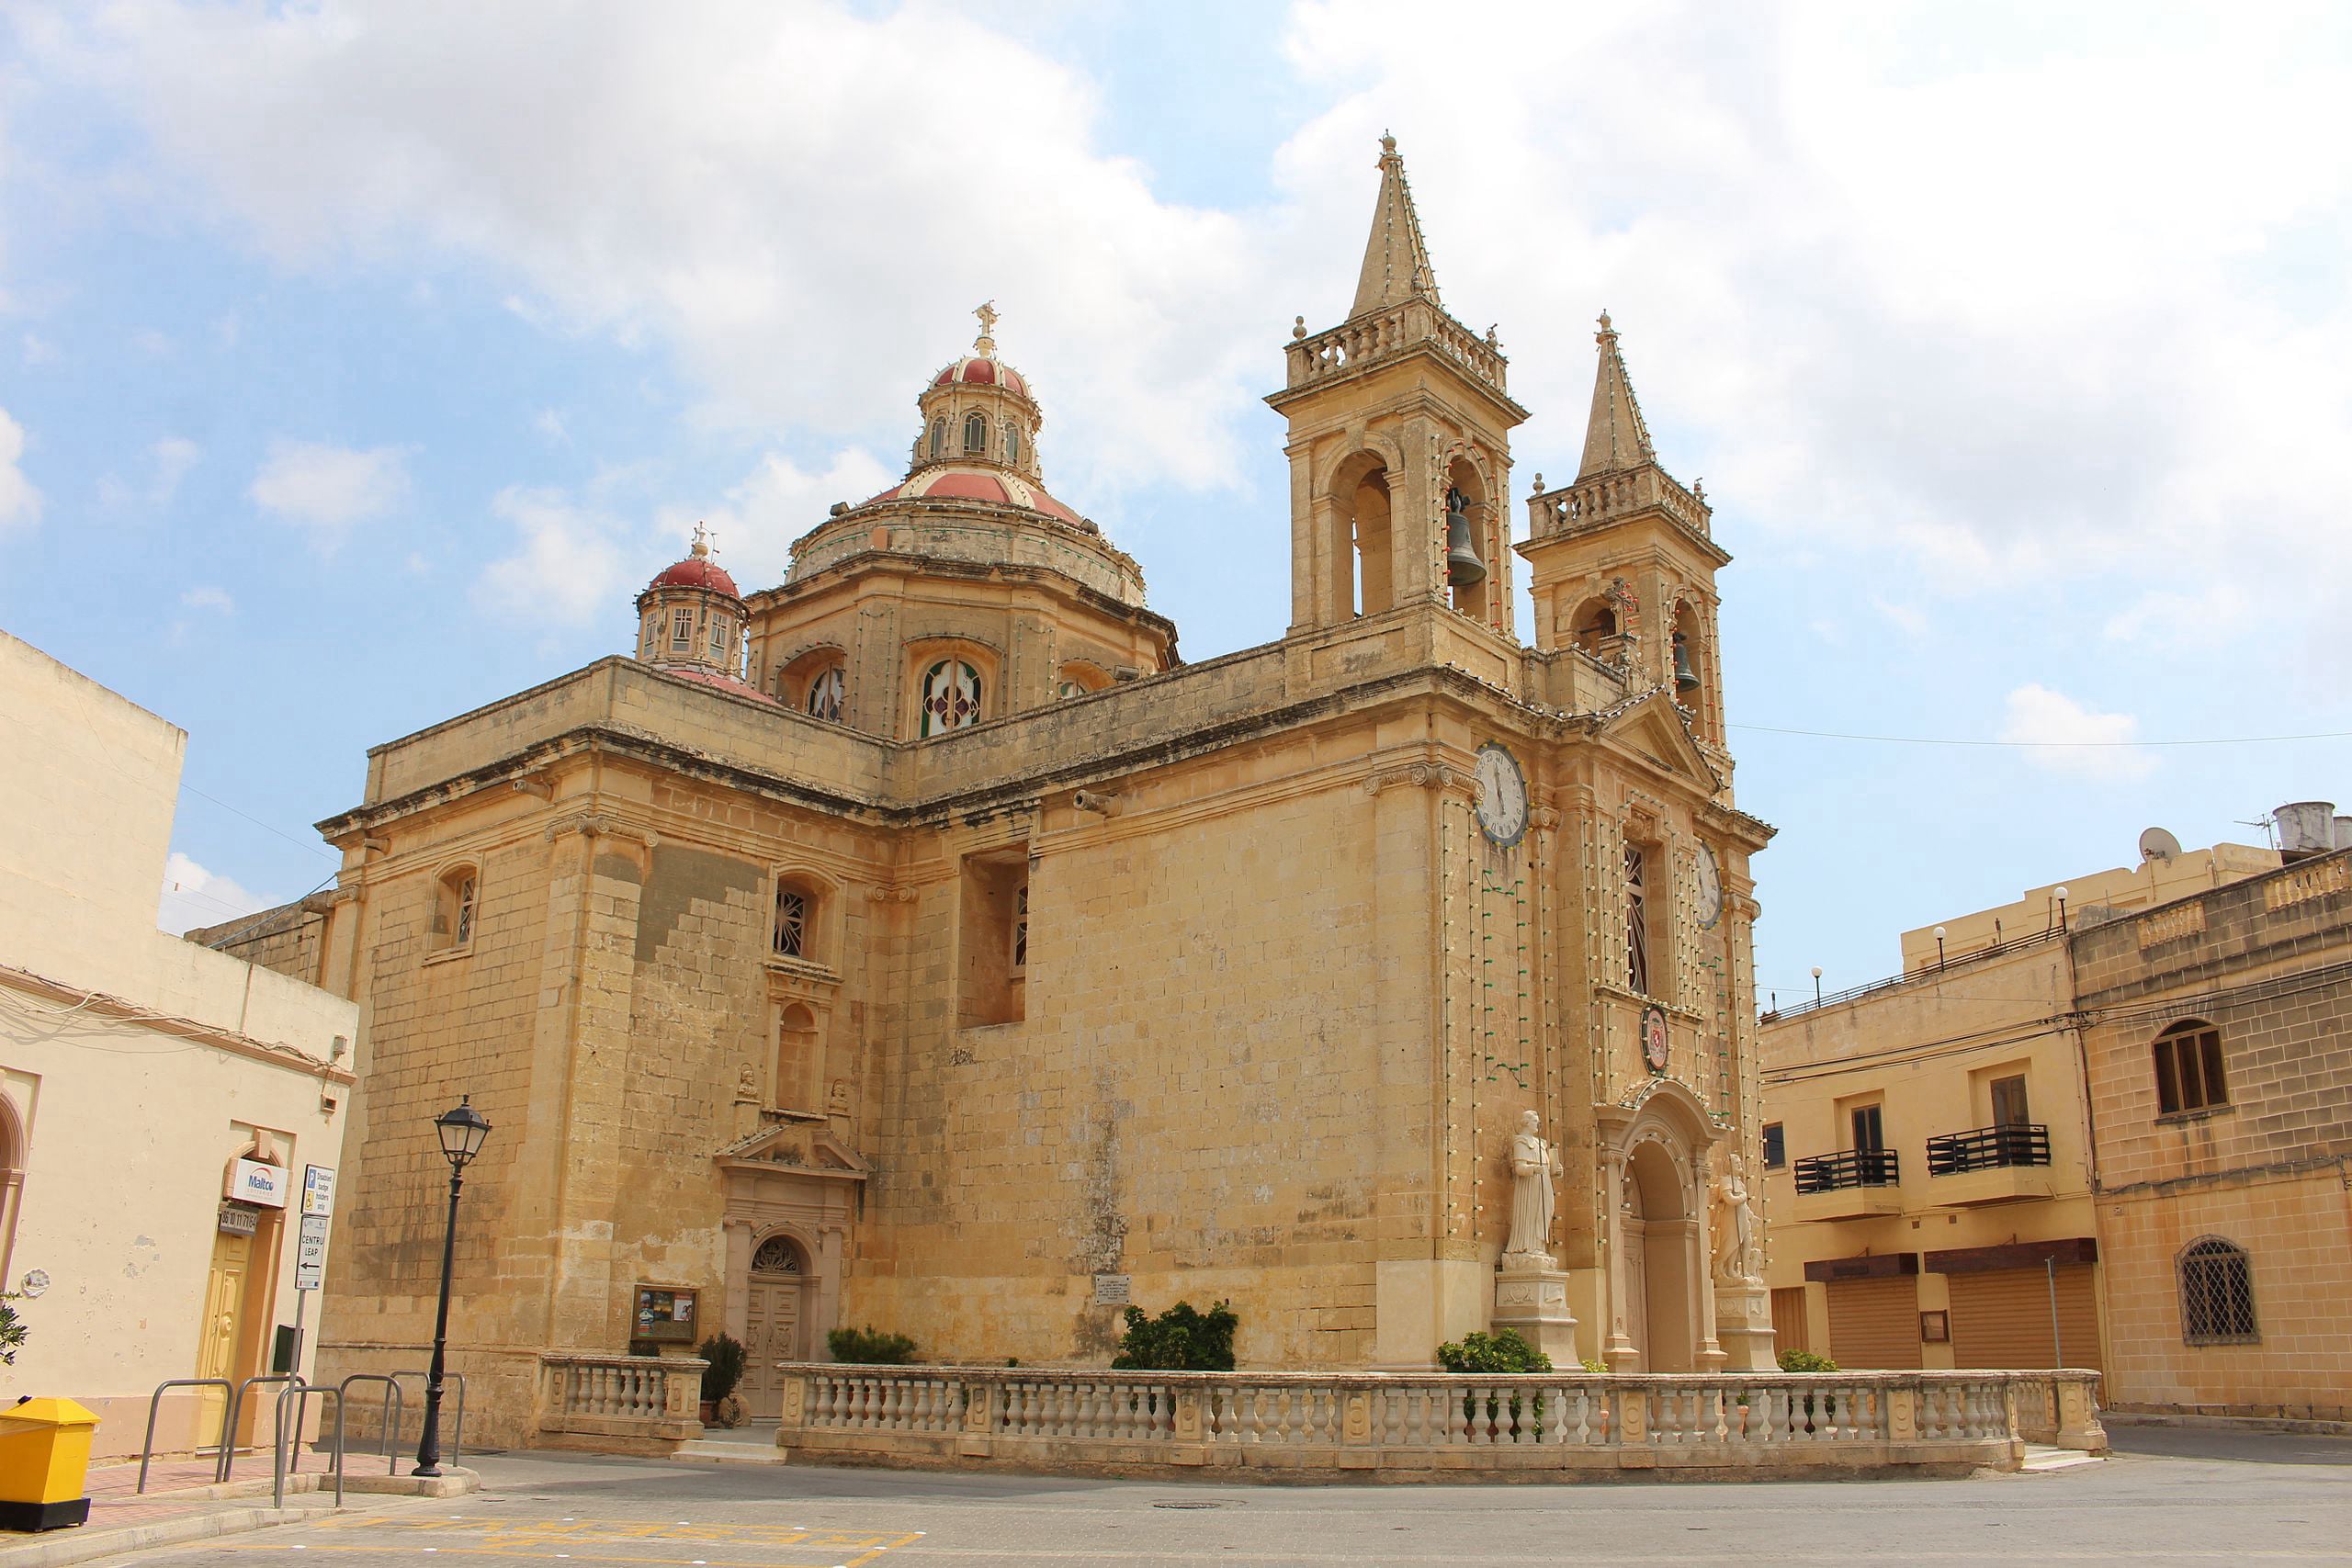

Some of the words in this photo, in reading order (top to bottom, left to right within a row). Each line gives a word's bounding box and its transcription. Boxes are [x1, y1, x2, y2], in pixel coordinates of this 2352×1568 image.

[317, 1172, 332, 1181] Disabled
[248, 1175, 274, 1191] Maltco
[318, 1182, 329, 1191] badge
[317, 1203, 325, 1212] only
[305, 1247, 319, 1257] LEAP
[308, 1517, 886, 1547] RESERVED
